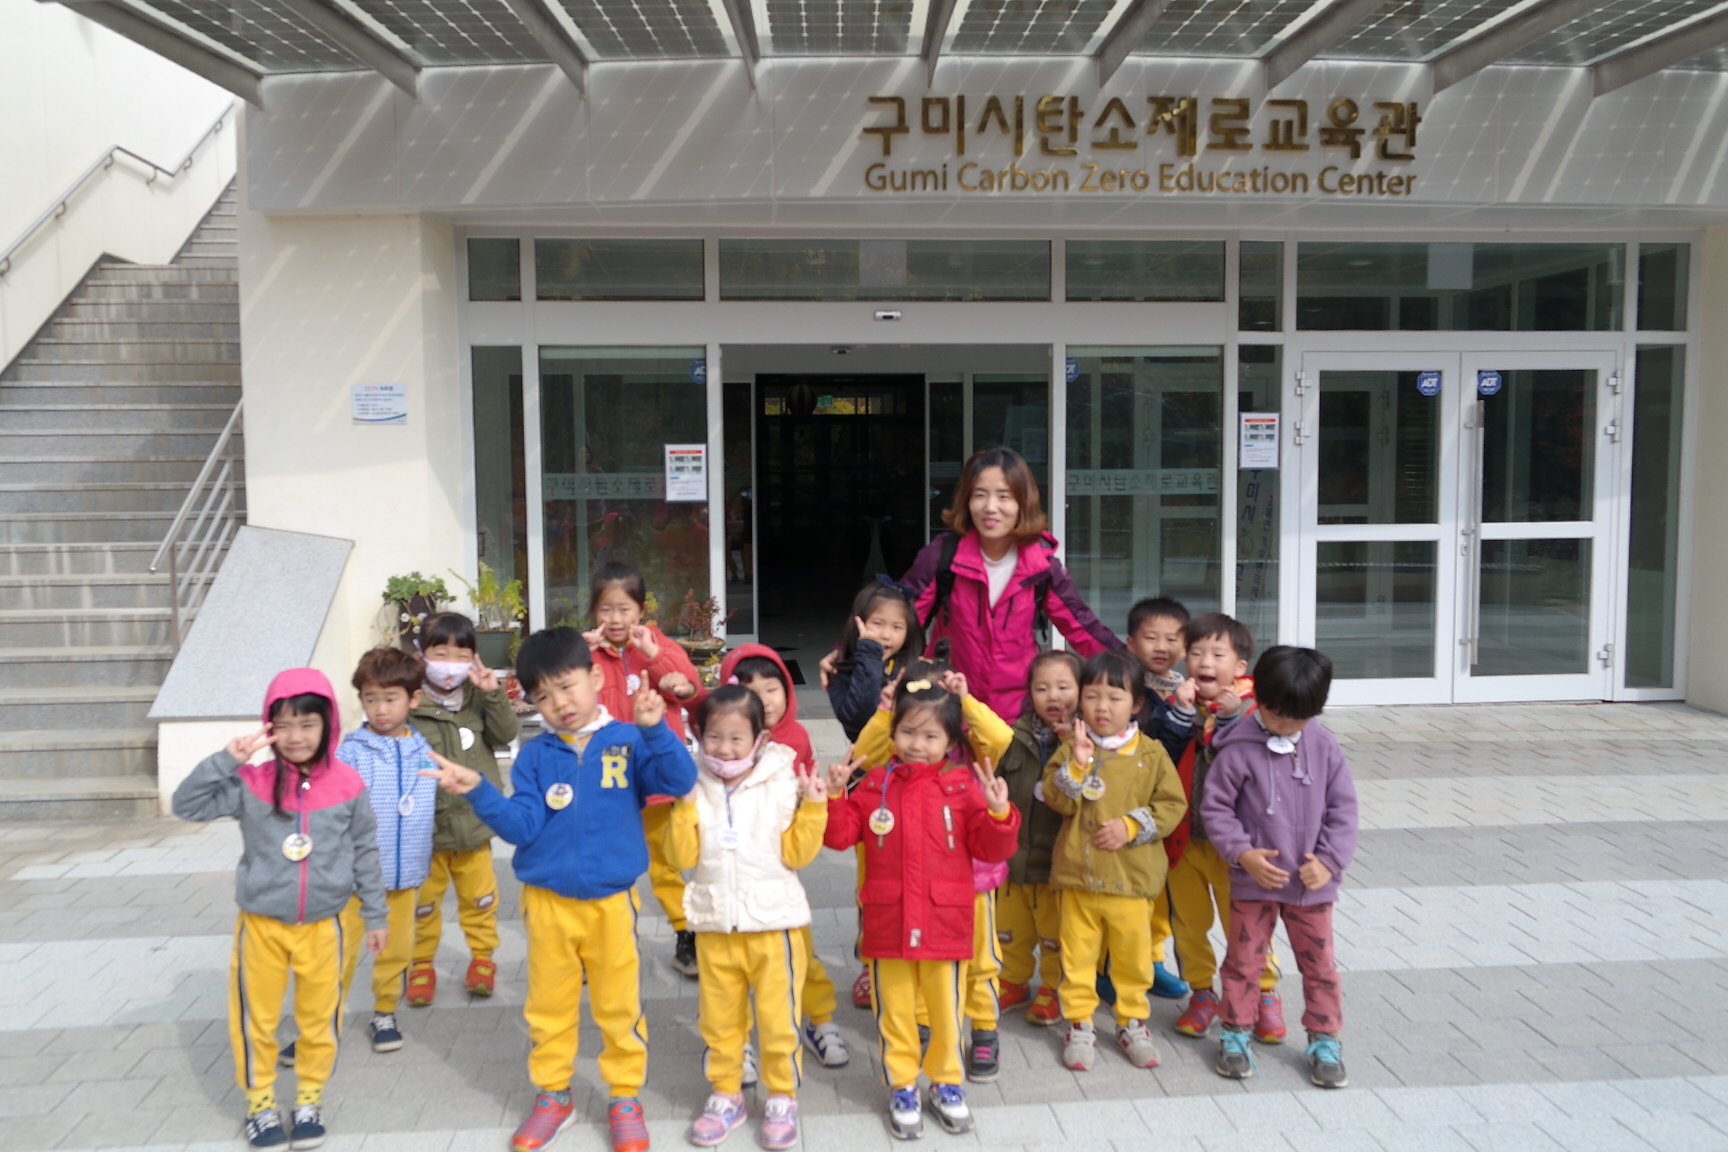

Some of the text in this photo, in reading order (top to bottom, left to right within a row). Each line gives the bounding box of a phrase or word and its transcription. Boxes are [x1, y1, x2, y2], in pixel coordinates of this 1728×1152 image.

[862, 94, 1423, 161] 구미시탄소제로교육관
[864, 162, 1417, 196] Gumi Carbon Zero Education Center
[1421, 378, 1438, 388] ADT
[1481, 377, 1498, 387] ADT
[600, 755, 628, 789] R
